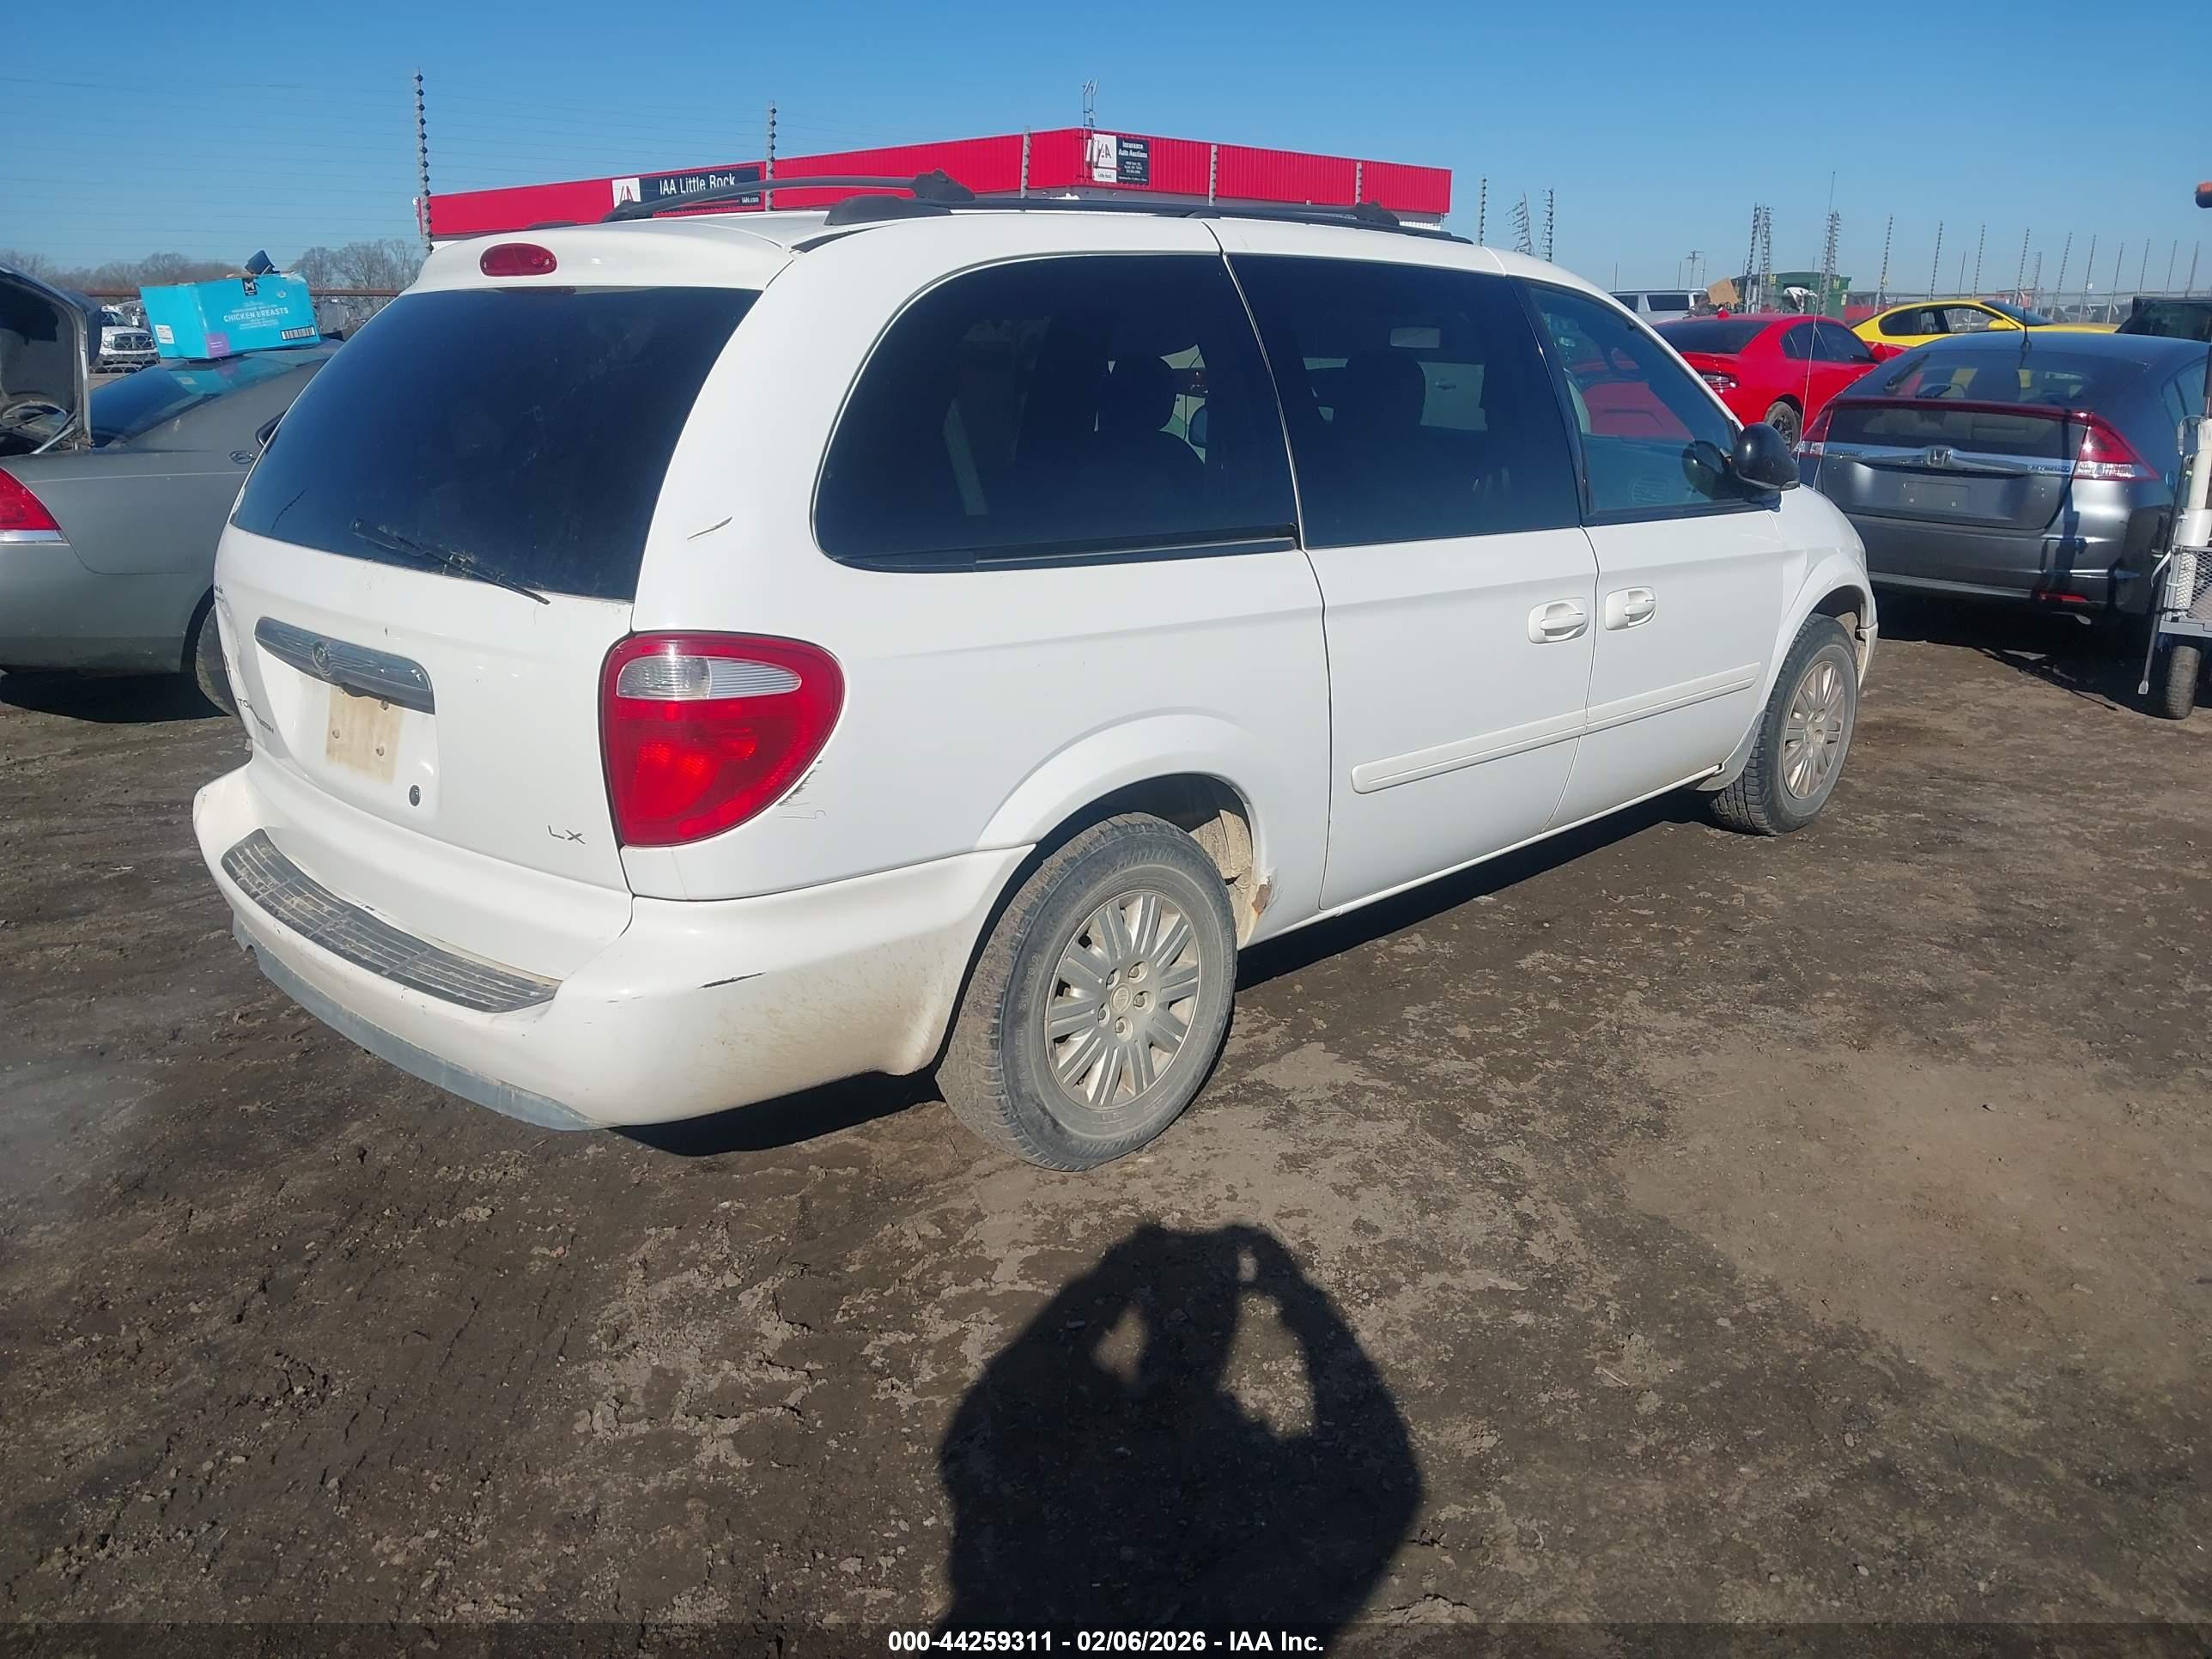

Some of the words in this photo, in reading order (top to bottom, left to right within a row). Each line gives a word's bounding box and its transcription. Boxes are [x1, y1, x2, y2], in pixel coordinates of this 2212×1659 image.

[1130, 149, 1147, 158] Auctions
[659, 179, 677, 196] IAA
[679, 175, 706, 195] Little
[709, 173, 735, 189] Rock
[223, 312, 255, 322] CHICKEN
[257, 307, 289, 318] BREASTS
[548, 825, 586, 845] LX
